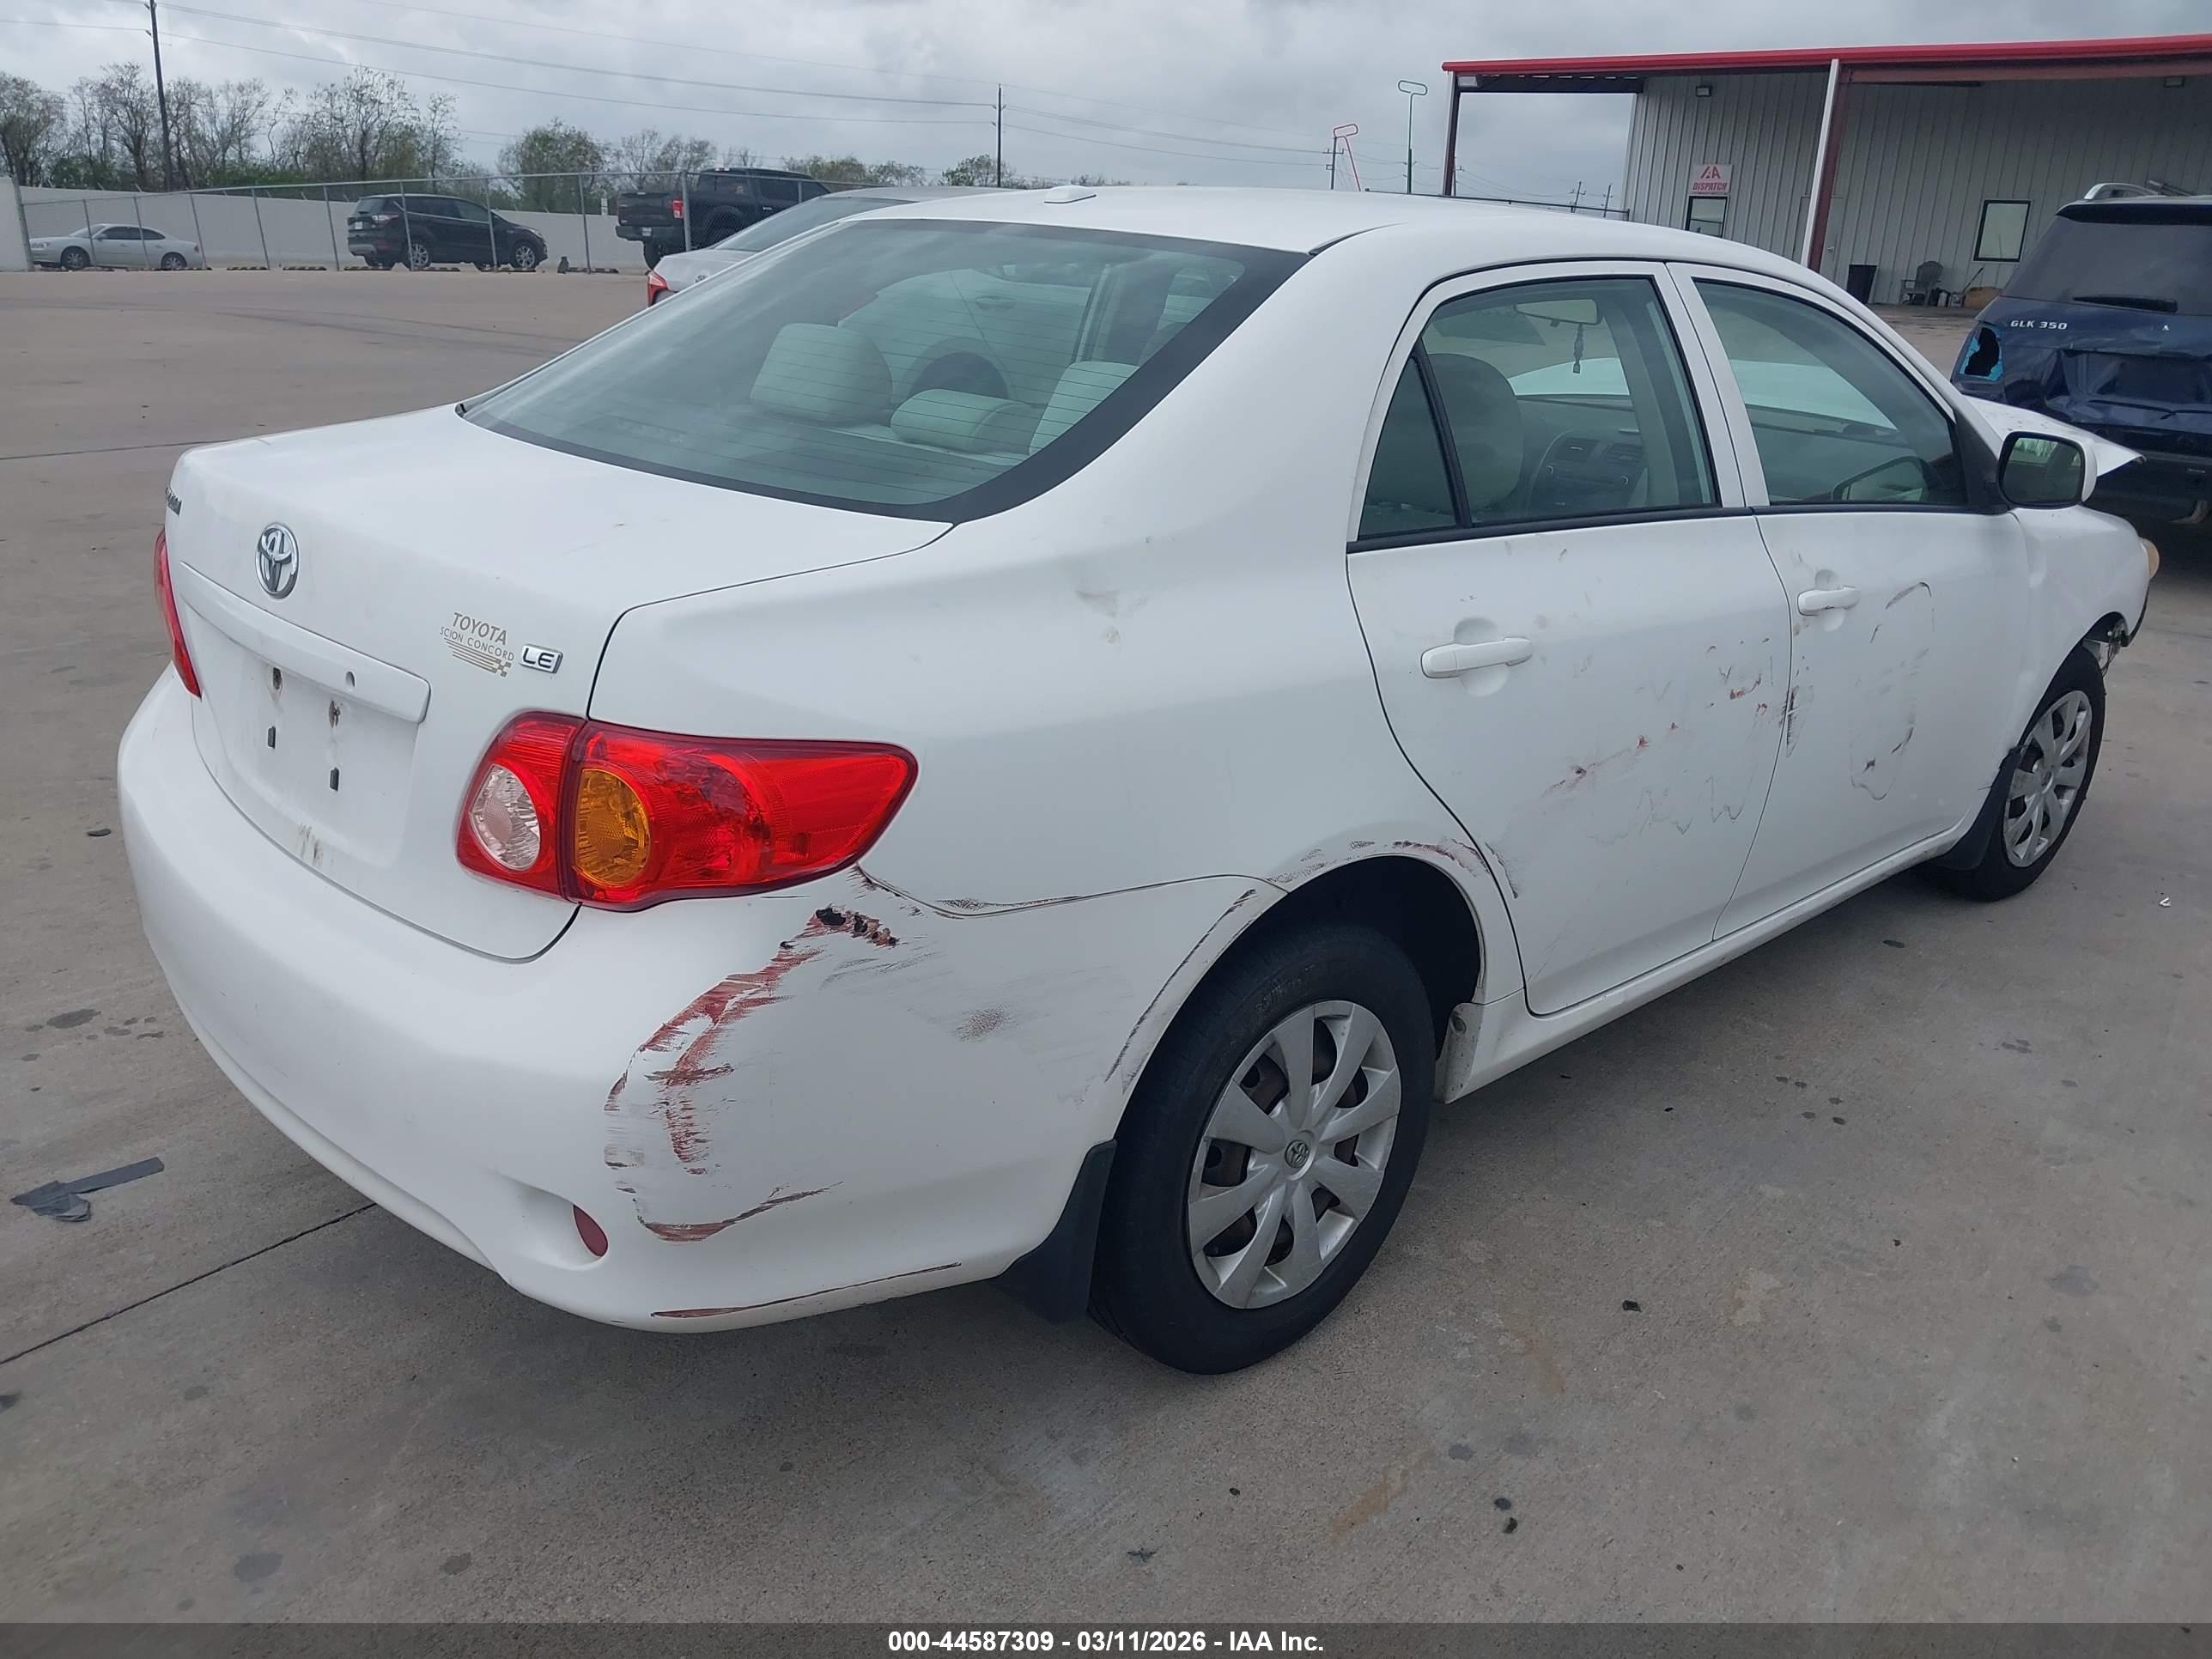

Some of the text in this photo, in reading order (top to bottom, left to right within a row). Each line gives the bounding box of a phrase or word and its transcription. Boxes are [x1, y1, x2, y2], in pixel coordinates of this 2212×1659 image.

[1692, 182, 1728, 191] DISPATCH
[2039, 321, 2068, 330] 350
[453, 612, 507, 645] TOYOTA
[440, 625, 514, 661] SCION CONCORD
[522, 647, 555, 669] LE
